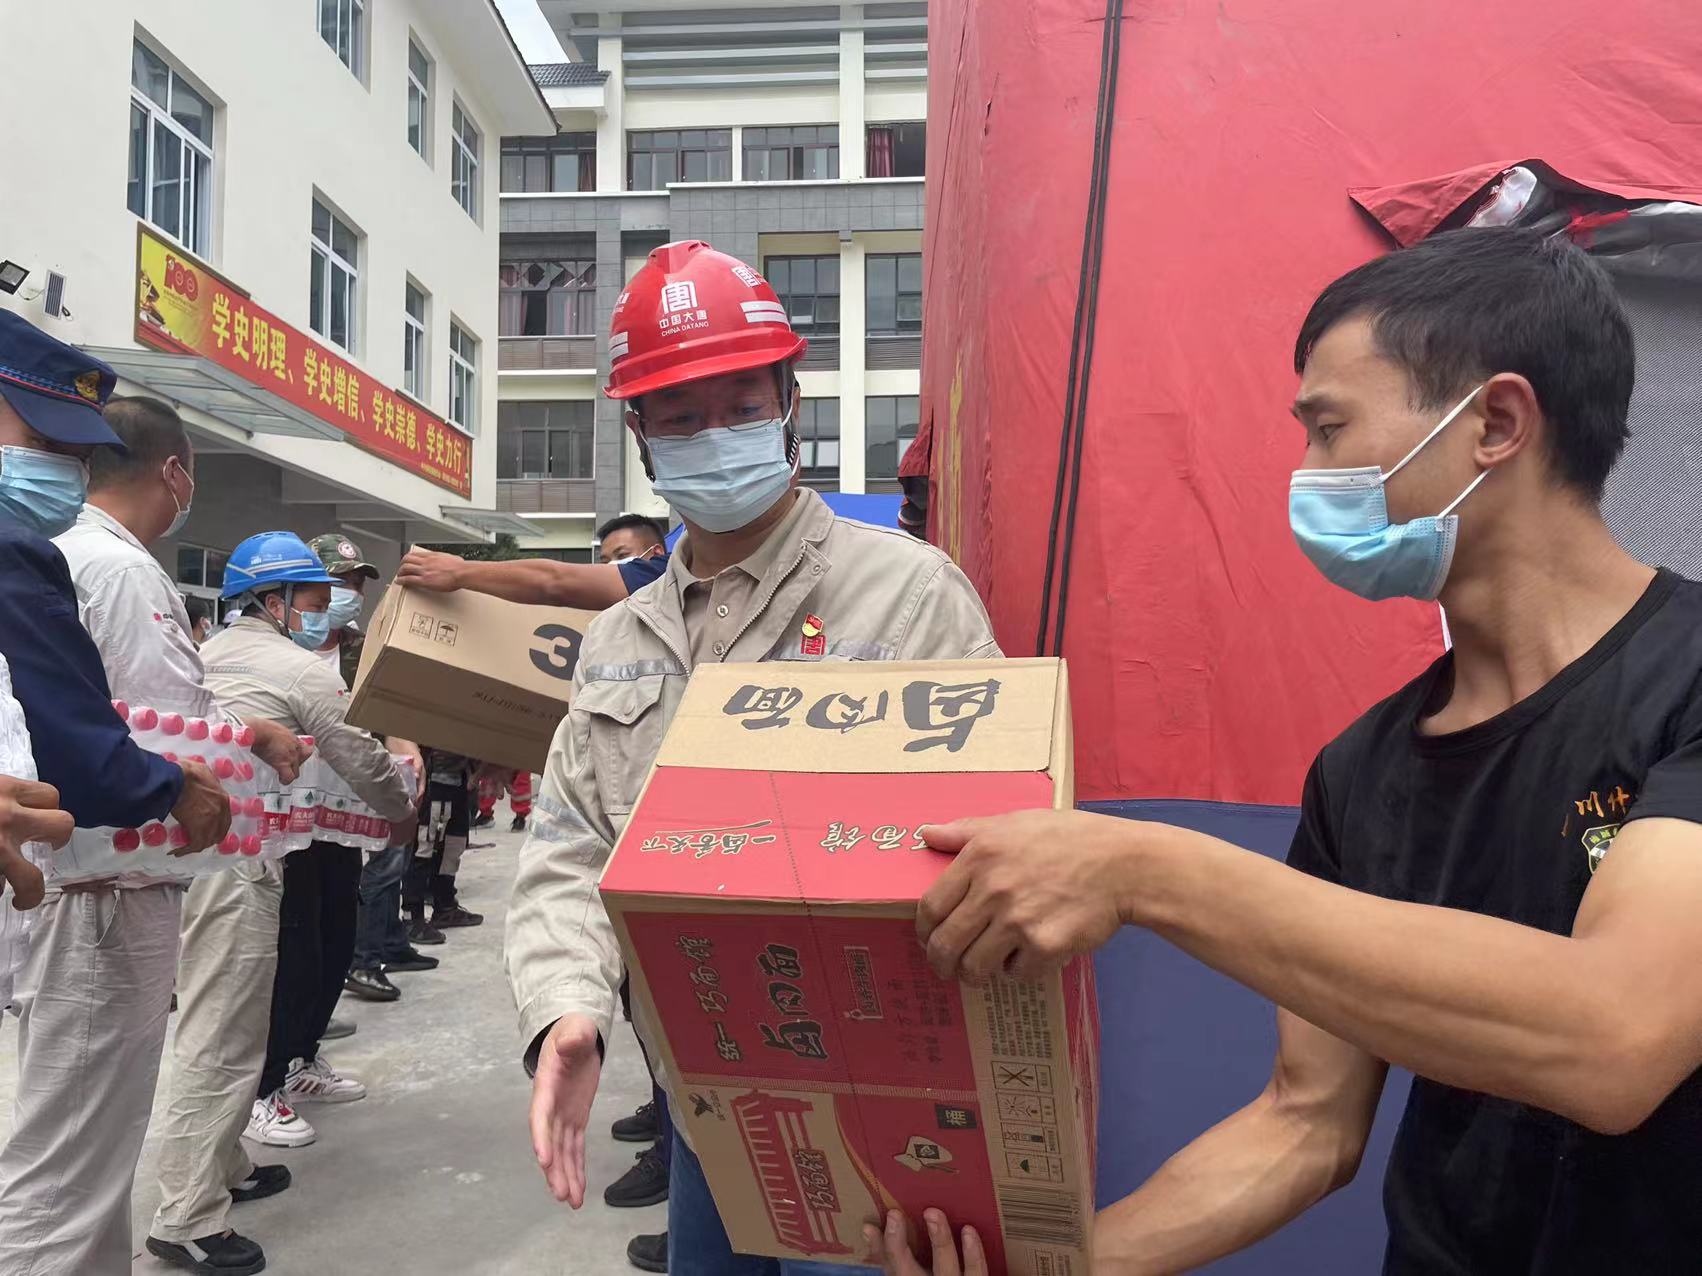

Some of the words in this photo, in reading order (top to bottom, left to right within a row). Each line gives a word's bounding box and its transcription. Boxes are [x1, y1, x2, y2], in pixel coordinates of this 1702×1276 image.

[659, 310, 708, 329] 中国大唐
[661, 326, 681, 337] CHINA
[722, 679, 1002, 753] 卤肉面
[639, 830, 776, 859] 一卤香天下
[757, 943, 829, 1060] 卤肉面
